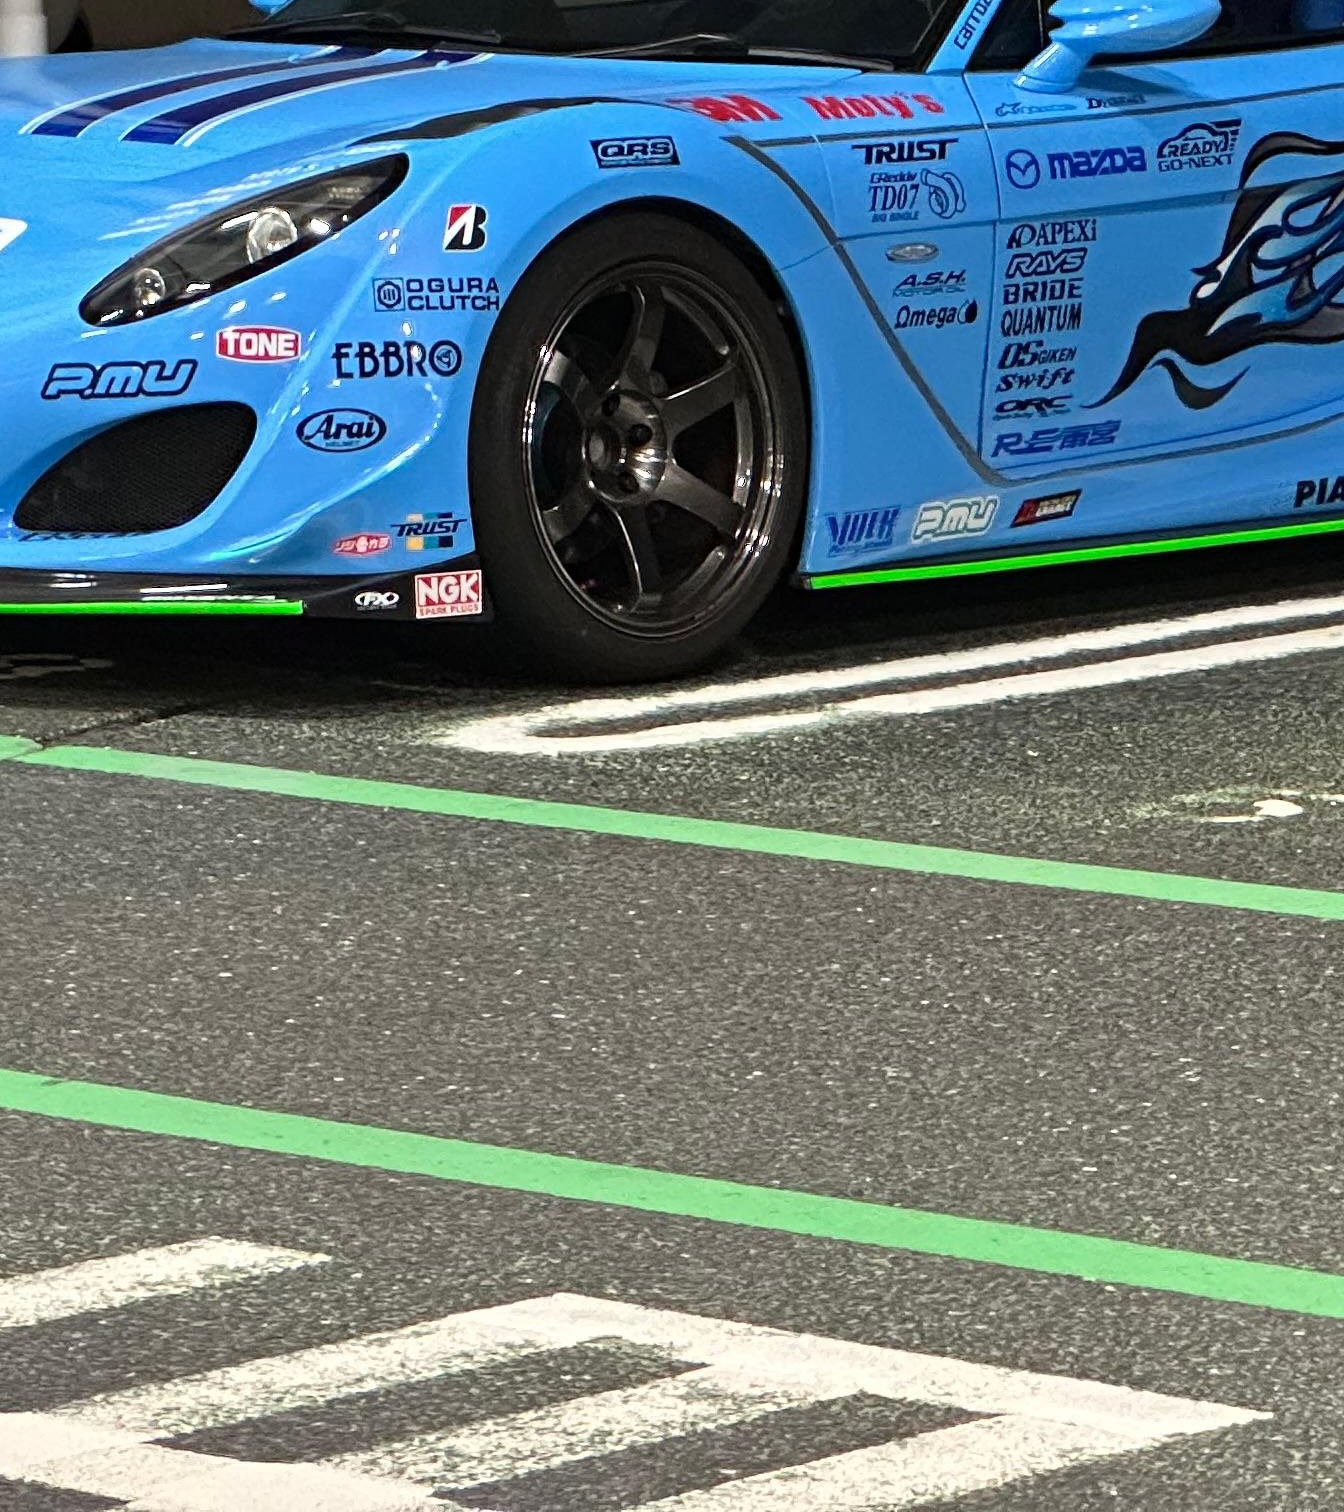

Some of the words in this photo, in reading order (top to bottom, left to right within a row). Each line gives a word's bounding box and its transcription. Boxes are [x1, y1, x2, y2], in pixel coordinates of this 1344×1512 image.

[851, 137, 959, 165] TRUST
[1157, 153, 1235, 172] GO-NEXT
[1167, 141, 1222, 158] READY
[868, 183, 920, 213] TD07
[1005, 247, 1089, 279] RAYS
[406, 277, 500, 294] OGURA
[1003, 277, 1084, 306] BRIDE
[407, 295, 500, 312] CLUTCH
[1000, 302, 1083, 338] QUANTUM
[222, 330, 296, 358] TONE
[331, 339, 463, 379] EBBRO
[306, 413, 376, 440] Arai
[390, 518, 468, 537] TRUST
[418, 573, 479, 606] NGK
